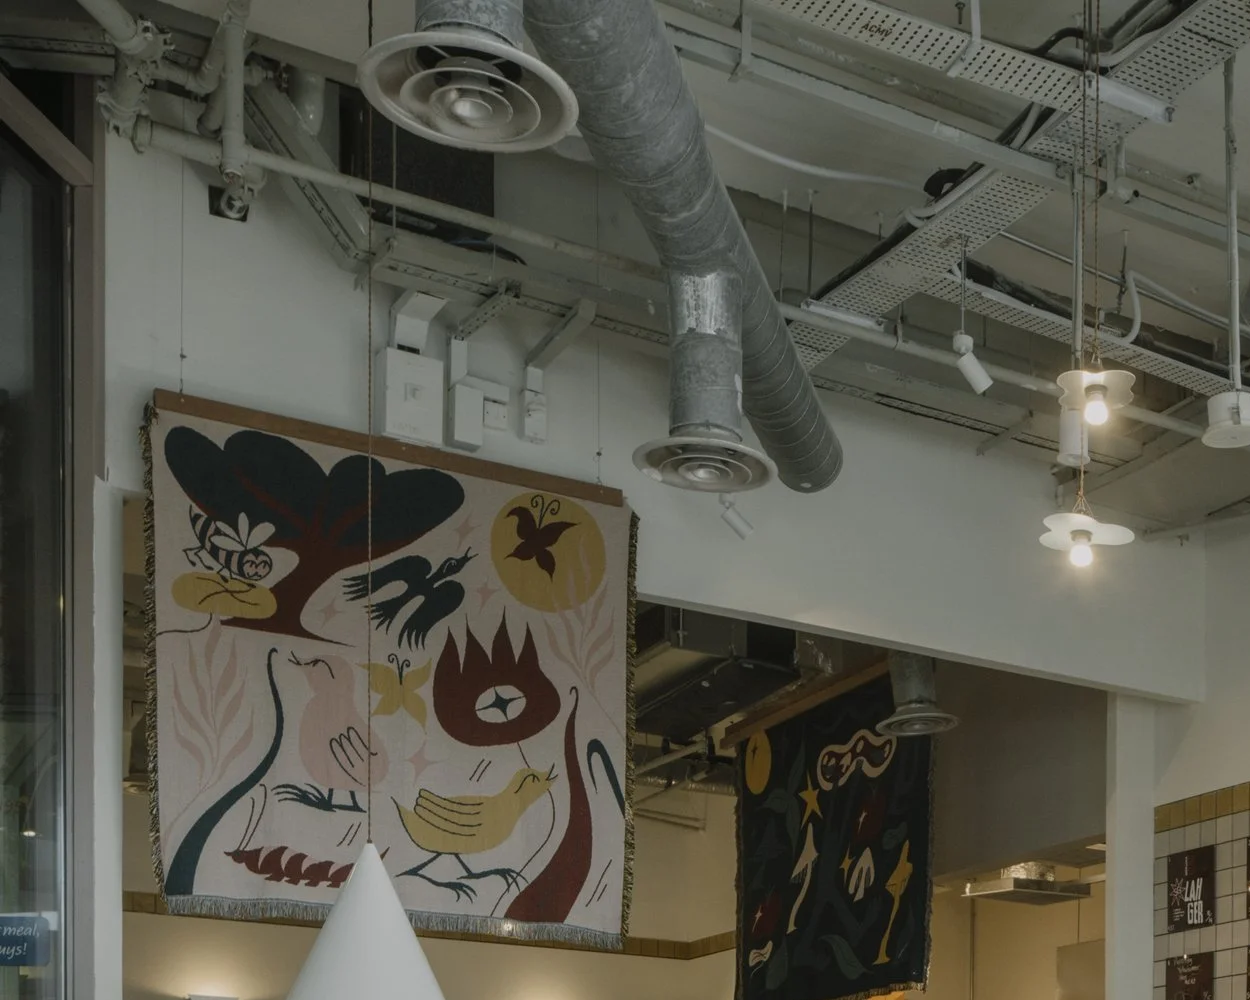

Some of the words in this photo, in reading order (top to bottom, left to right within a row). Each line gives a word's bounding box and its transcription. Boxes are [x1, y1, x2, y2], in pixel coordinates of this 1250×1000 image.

[860, 22, 893, 38] ACMV
[1184, 877, 1203, 902] LAH
[1187, 900, 1203, 925] GER
[3, 923, 40, 938] meal,
